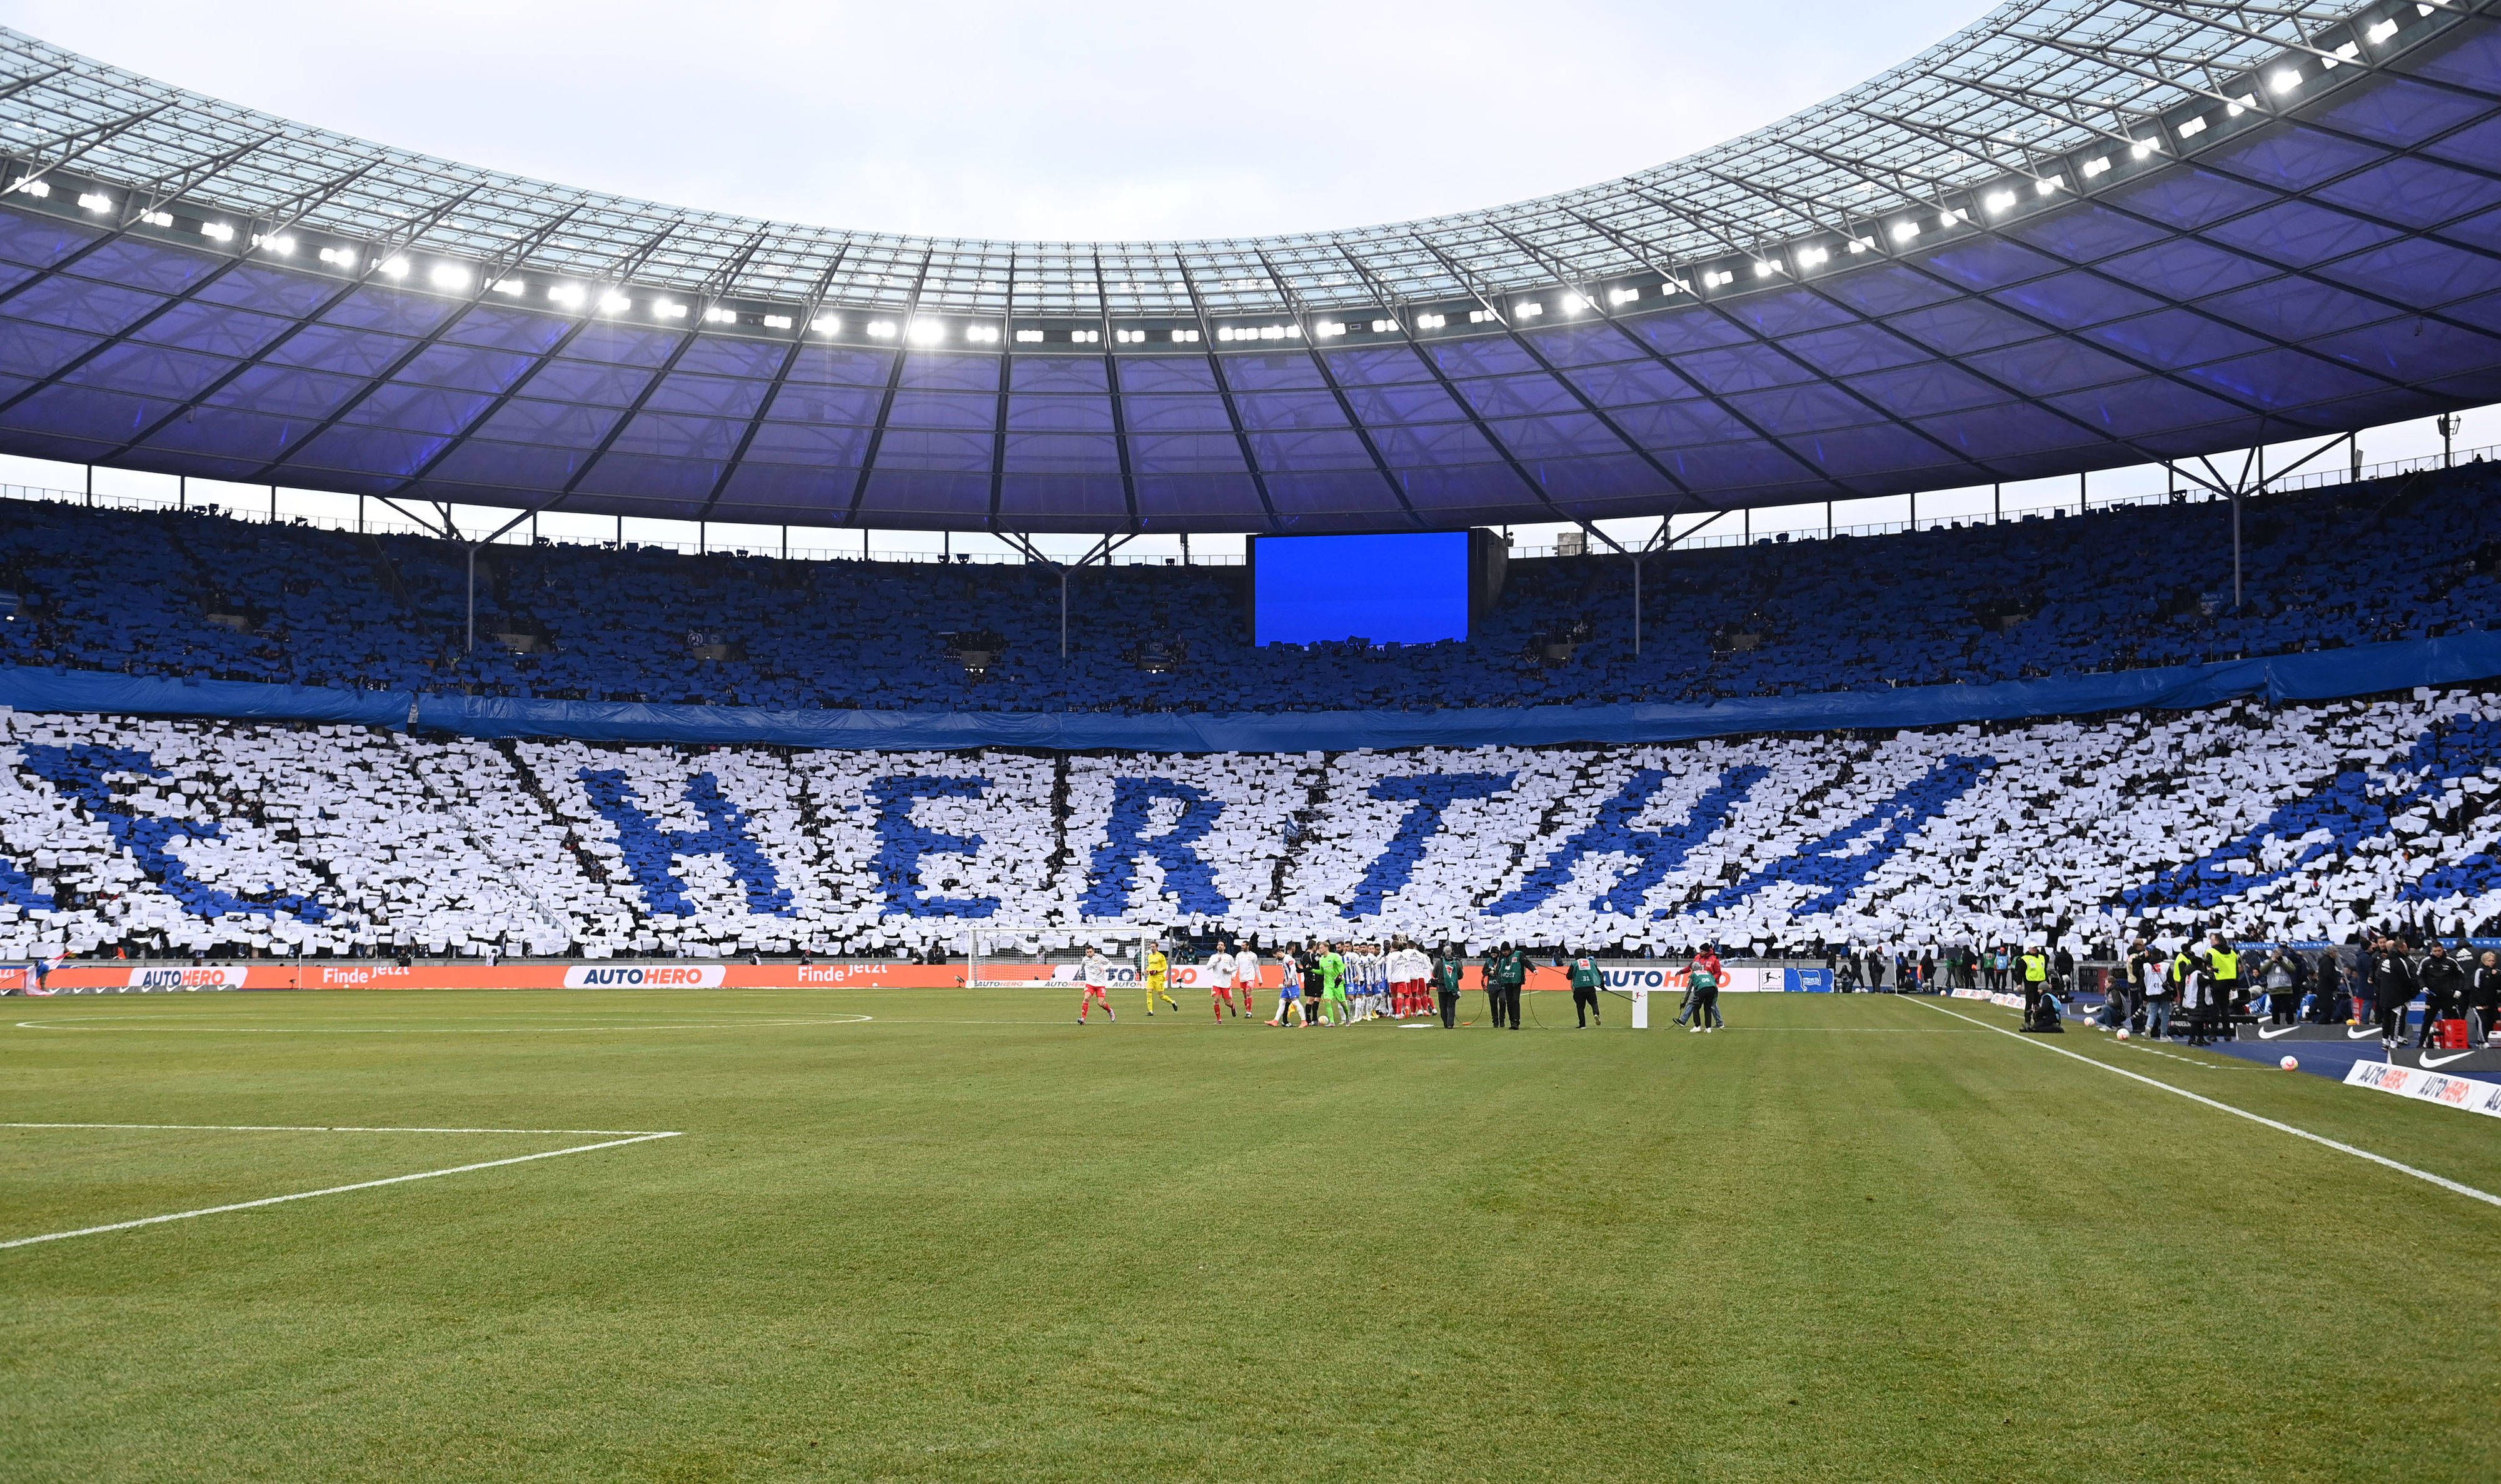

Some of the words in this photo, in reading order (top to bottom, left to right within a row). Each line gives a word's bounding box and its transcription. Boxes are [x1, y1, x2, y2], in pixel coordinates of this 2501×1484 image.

[575, 753, 1997, 919] HERTHA
[142, 970, 226, 986] AUTOHERO
[323, 968, 368, 983] Finde
[583, 969, 702, 984] AUTOHERO
[798, 966, 844, 981] Finde
[2357, 1065, 2410, 1090] AUTOHERO
[2417, 1076, 2470, 1103] AUTOHERO
